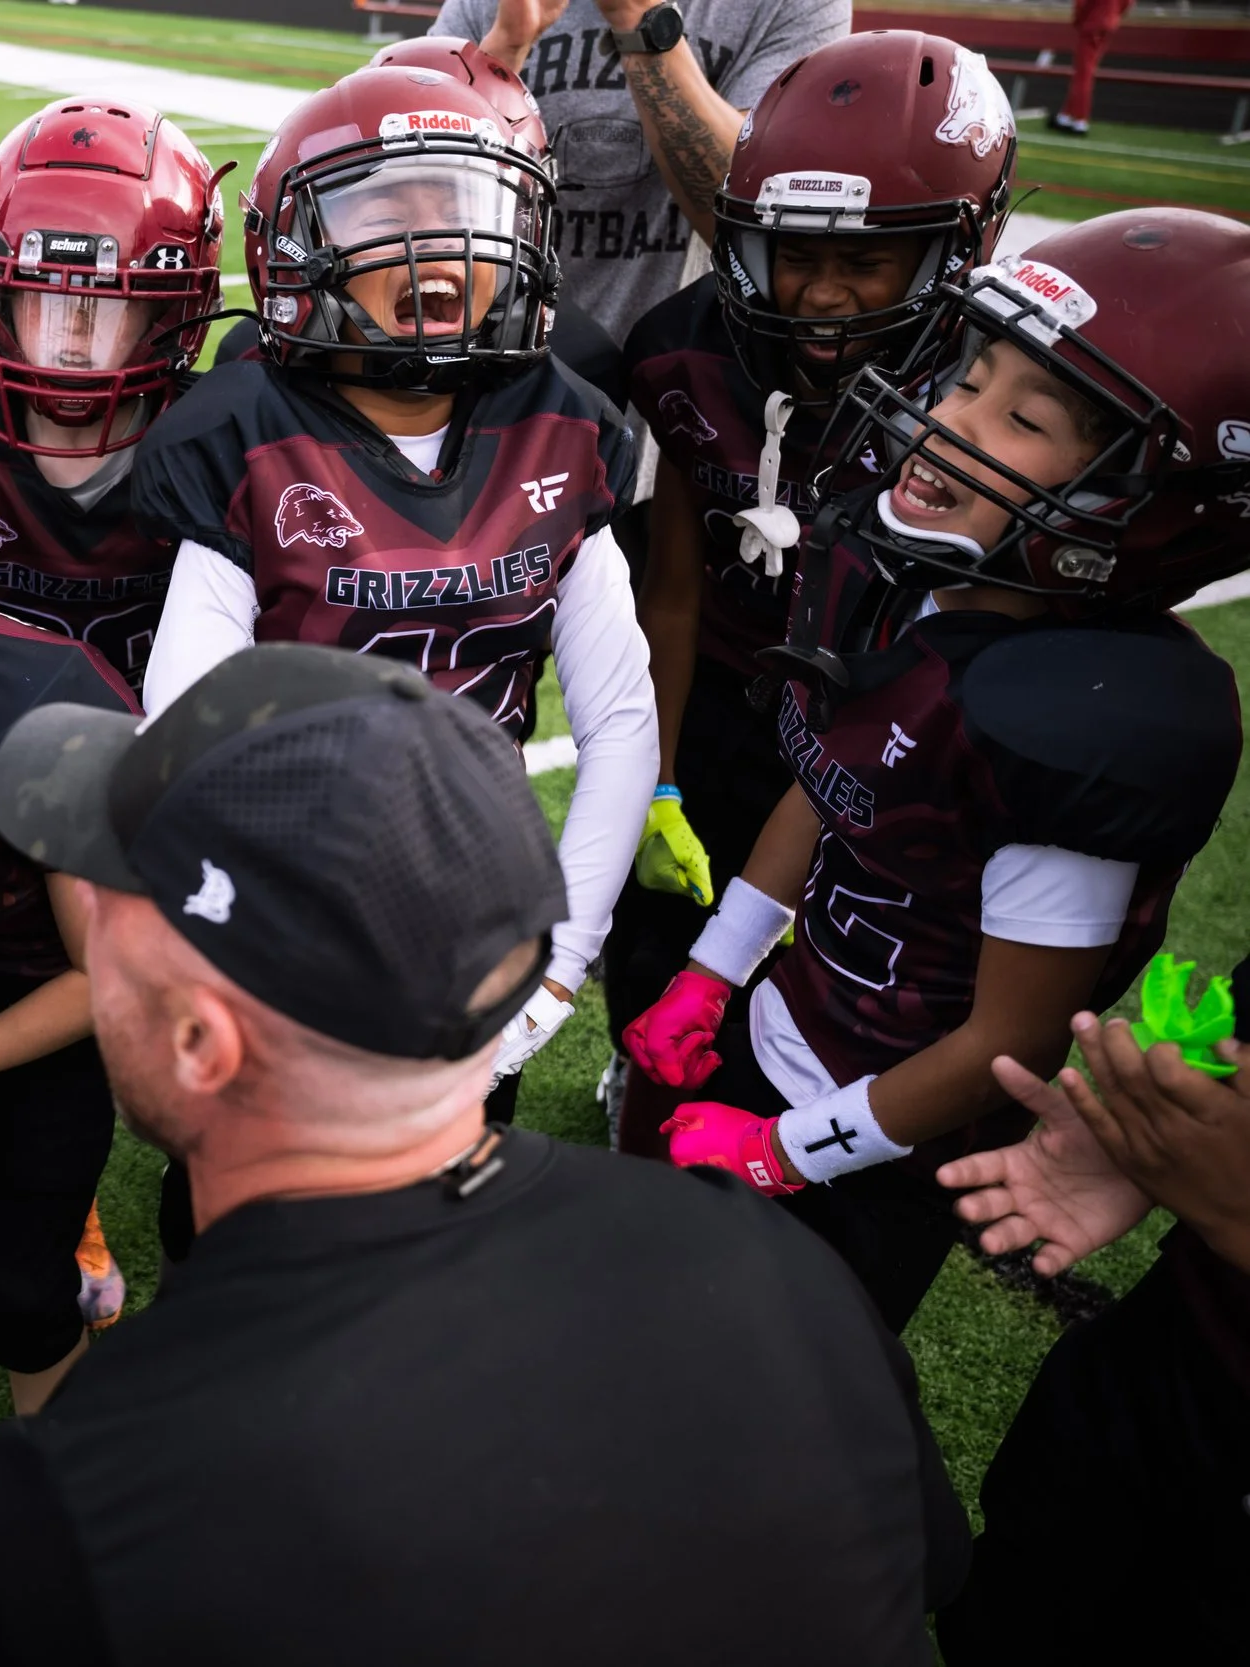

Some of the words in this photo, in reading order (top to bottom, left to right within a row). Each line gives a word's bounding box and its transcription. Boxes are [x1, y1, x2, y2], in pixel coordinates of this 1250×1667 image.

[408, 114, 472, 132] Riddell
[789, 178, 843, 193] GRIZZLIES
[50, 238, 88, 253] schutt
[280, 238, 309, 262] BATTL
[520, 472, 569, 514] RF
[326, 543, 552, 610] GRIZZLIES
[779, 680, 875, 829] RIZZLIES
